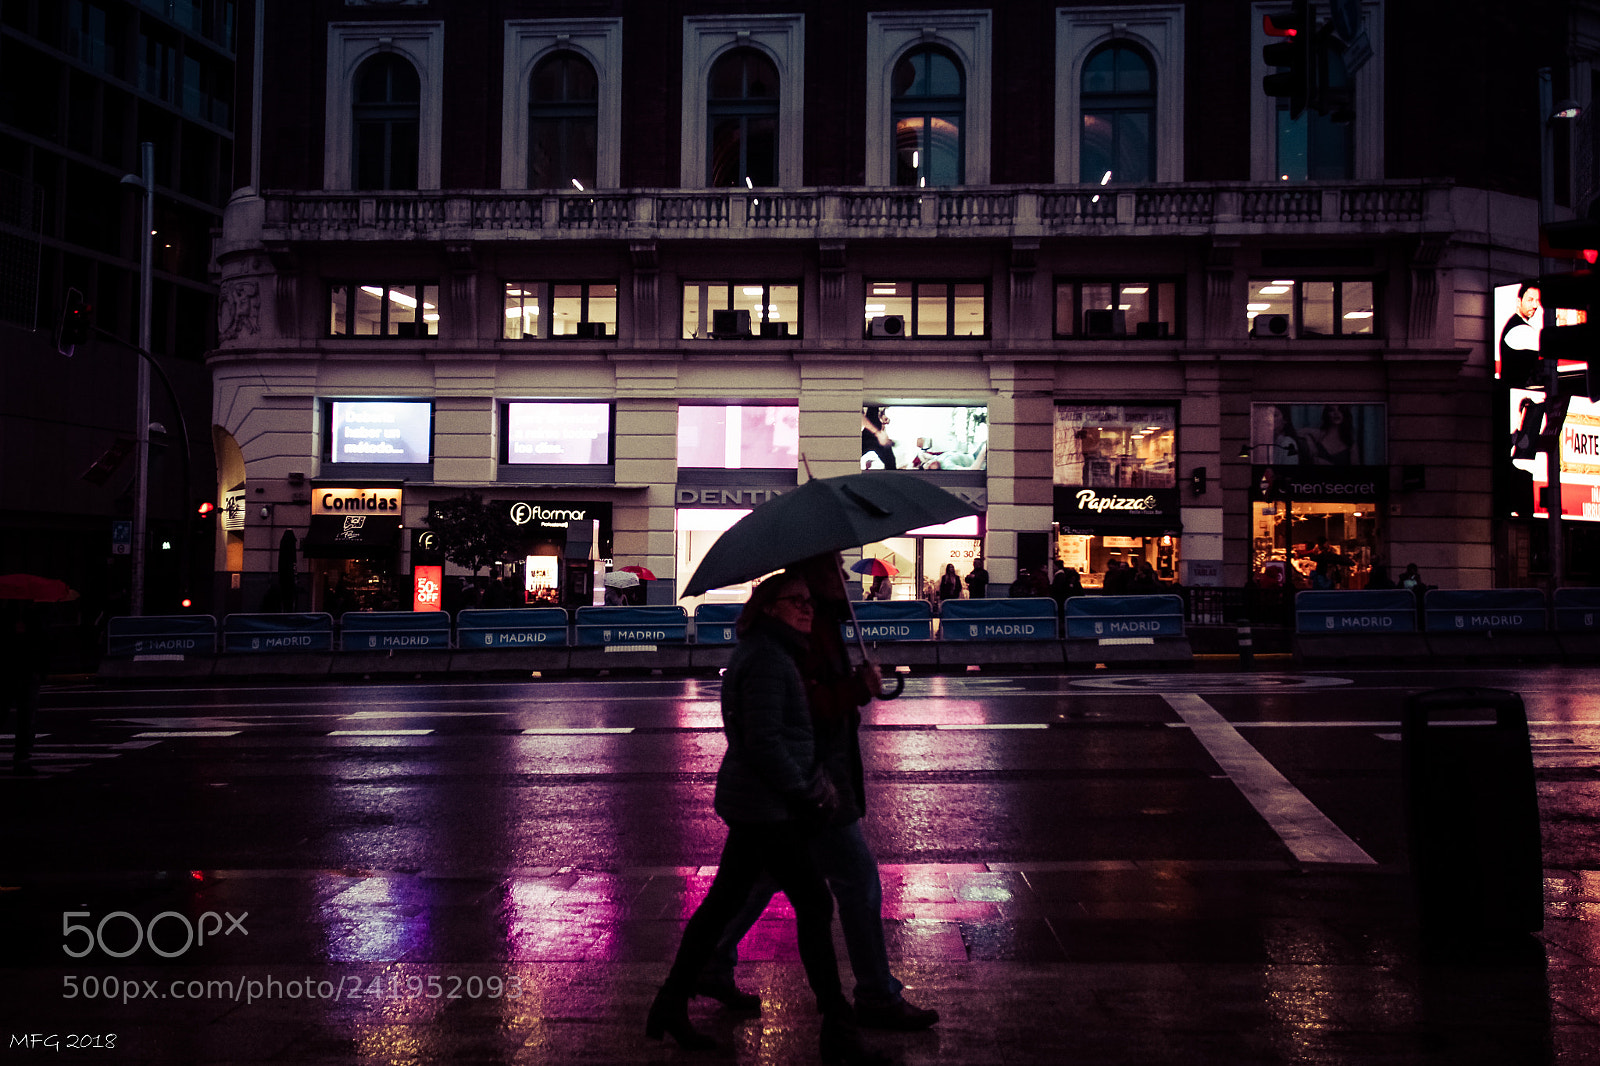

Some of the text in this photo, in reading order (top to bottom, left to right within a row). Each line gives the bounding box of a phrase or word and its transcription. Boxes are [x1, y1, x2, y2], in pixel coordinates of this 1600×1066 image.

[322, 493, 397, 511] Comidas
[1076, 489, 1146, 513] Papizza
[532, 505, 586, 521] flormar
[950, 550, 960, 558] 20
[963, 550, 974, 558] 30
[417, 592, 439, 602] OFF
[1341, 616, 1392, 627] MADRID
[1471, 615, 1523, 626] MADRID
[861, 626, 910, 637] MADRID
[985, 624, 1035, 635] MADRID
[1110, 621, 1161, 632] MADRID
[265, 635, 312, 647] MADRID
[383, 635, 429, 646] MADRID
[499, 632, 547, 643] MADRID
[617, 630, 666, 641] MADRID
